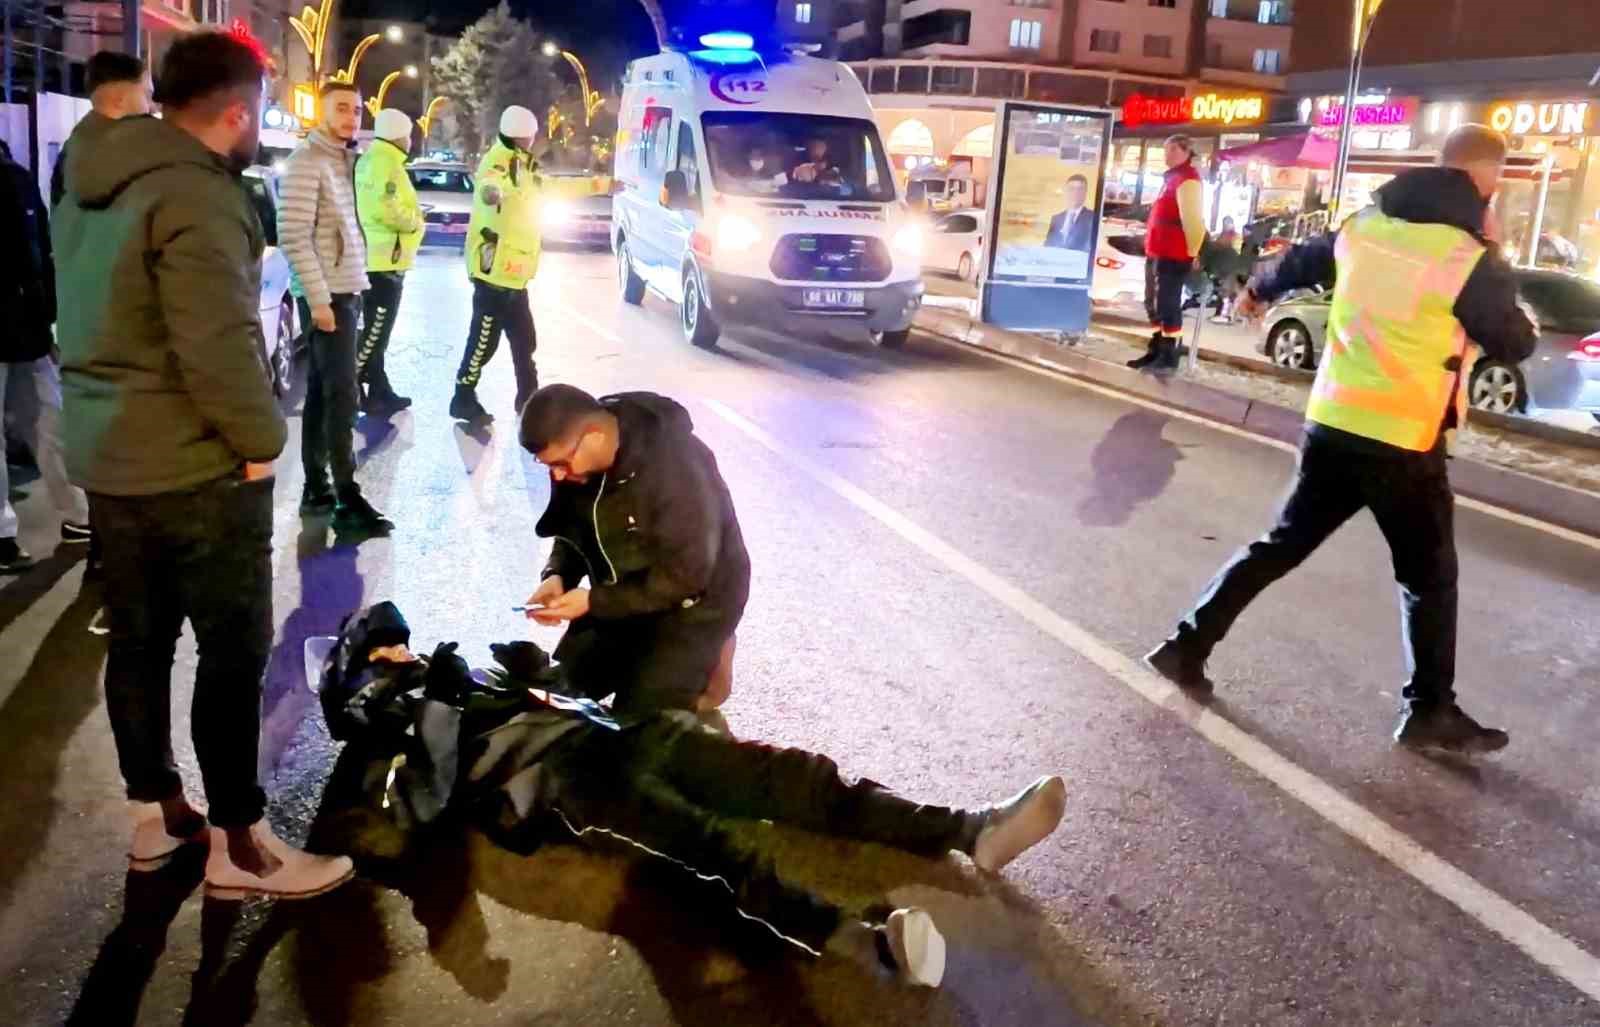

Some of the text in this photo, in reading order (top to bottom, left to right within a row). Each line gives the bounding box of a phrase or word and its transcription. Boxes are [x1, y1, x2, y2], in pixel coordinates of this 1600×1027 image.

[724, 80, 768, 94] 112
[1146, 97, 1187, 119] Tavuk
[1491, 102, 1588, 134] ODUN
